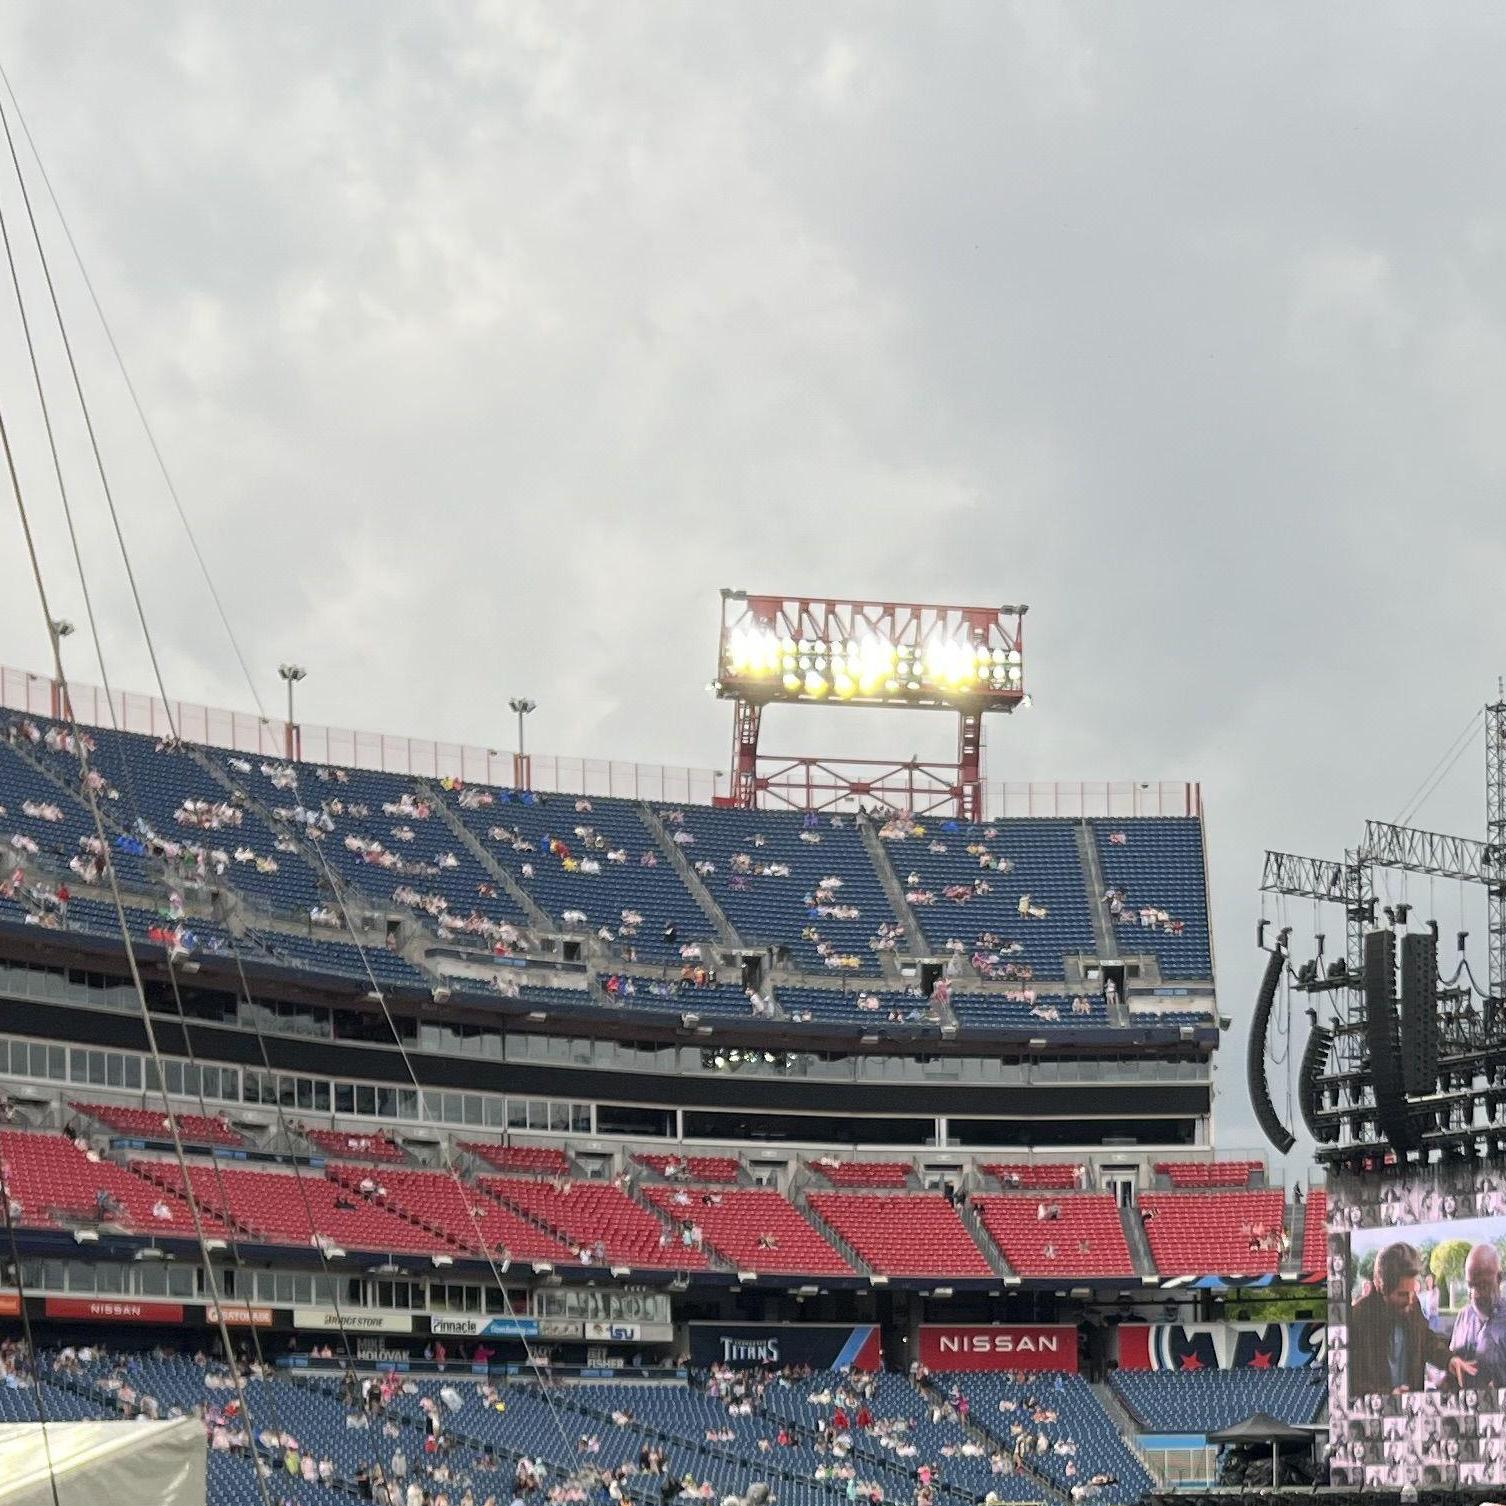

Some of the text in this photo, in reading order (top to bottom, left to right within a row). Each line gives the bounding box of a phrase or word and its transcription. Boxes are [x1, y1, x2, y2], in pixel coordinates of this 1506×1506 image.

[90, 1302, 142, 1317] NISSAN
[720, 1336, 778, 1361] TITANS
[940, 1336, 1057, 1352] NISSAN
